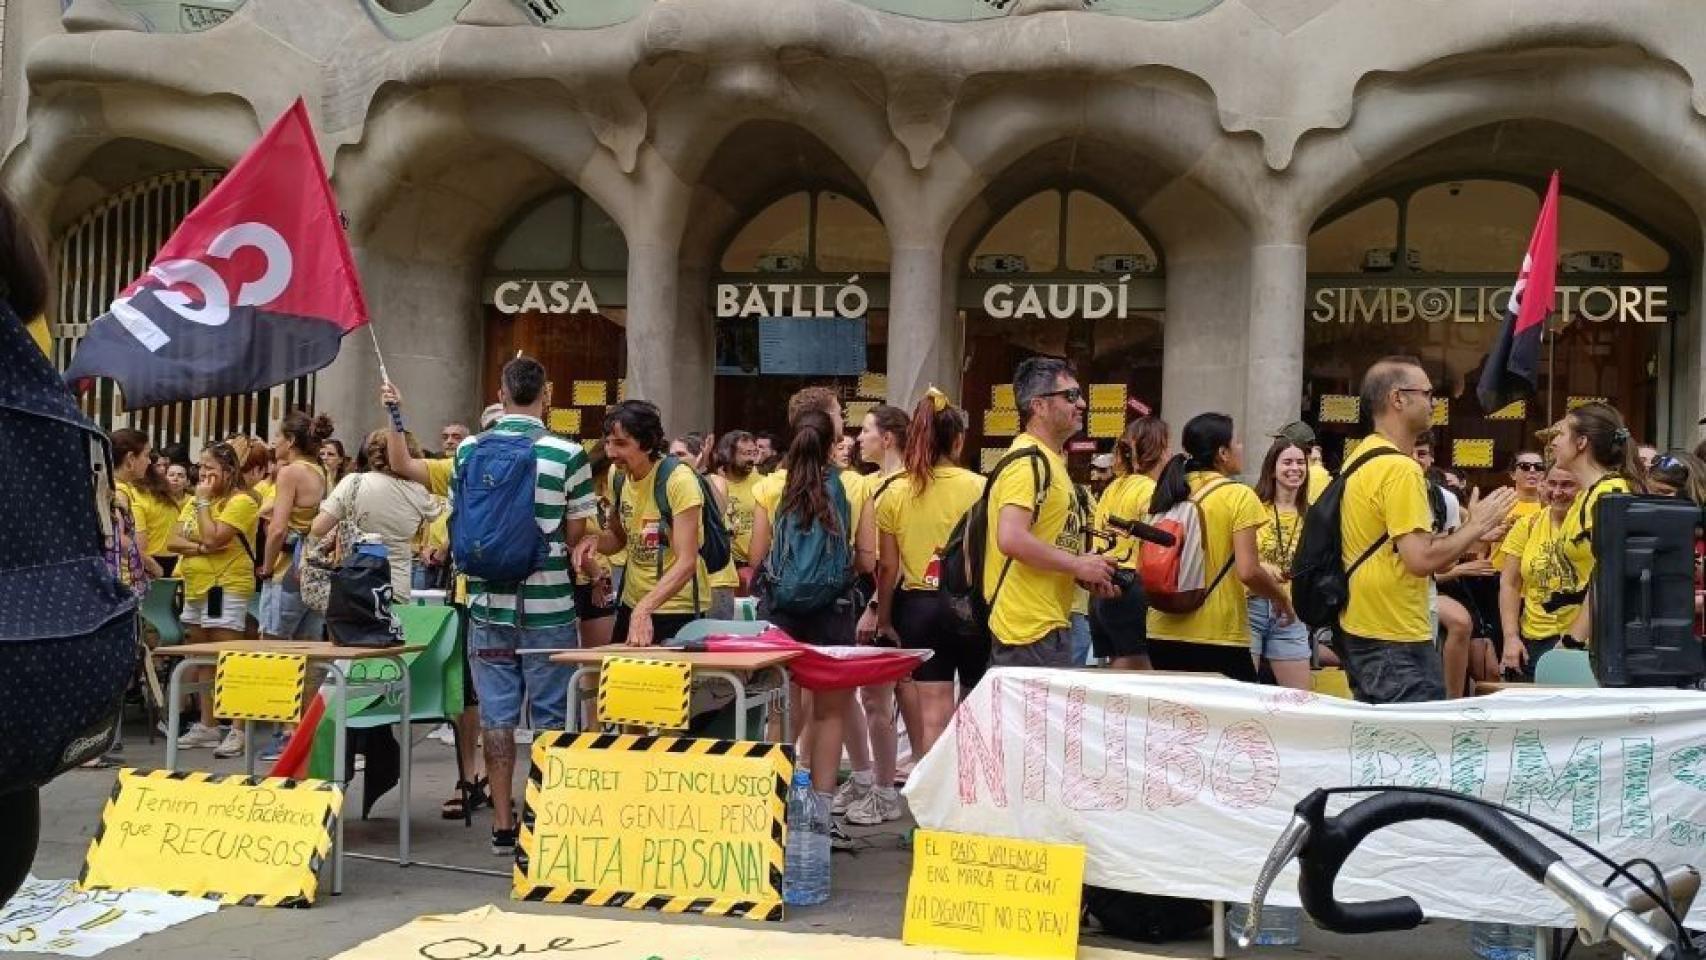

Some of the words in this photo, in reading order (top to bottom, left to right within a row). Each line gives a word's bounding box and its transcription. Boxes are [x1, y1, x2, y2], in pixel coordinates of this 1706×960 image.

[494, 281, 598, 314] CASA
[717, 275, 868, 318] BATLLÓ
[984, 275, 1131, 319] GAUDÍ
[1554, 286, 1668, 323] TORE
[545, 755, 622, 791] DECRET
[136, 787, 198, 816] Tenim
[208, 795, 246, 820] més
[543, 801, 603, 827] SONA
[120, 821, 152, 848] que
[925, 839, 939, 856] EL
[537, 835, 623, 885] FALTA
[641, 838, 771, 895] PERSONAL
[927, 866, 950, 883] ENS
[957, 869, 994, 889] MARCA
[1005, 874, 1020, 892] EL
[995, 906, 1011, 929] NO
[1018, 907, 1032, 933] ES
